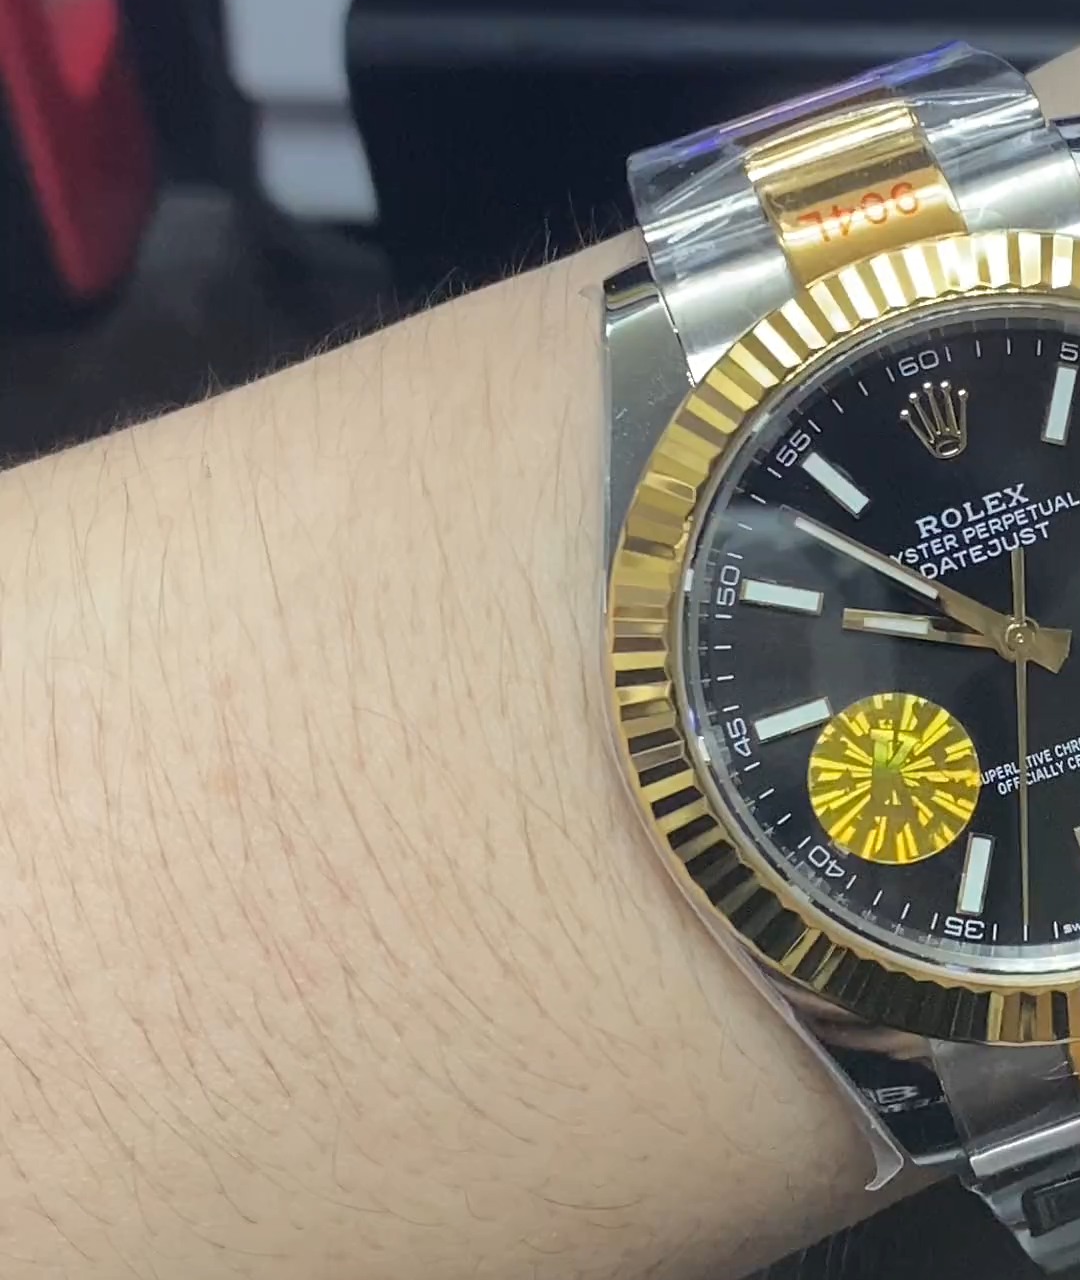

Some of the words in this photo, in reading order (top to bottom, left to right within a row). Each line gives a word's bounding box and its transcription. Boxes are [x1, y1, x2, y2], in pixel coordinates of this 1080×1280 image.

[898, 349, 940, 377] 60
[1060, 341, 1080, 362] 5
[775, 429, 812, 467] 55
[889, 533, 960, 567] YSTER
[962, 491, 1080, 545] PERPETUAL
[915, 482, 1030, 540] ROLEX
[919, 520, 1050, 581] DATEJUST
[716, 564, 741, 607] 50
[726, 717, 752, 757] 45
[979, 749, 1053, 786] UPERLTIVE
[997, 760, 1065, 796] OFFCIALLY
[807, 844, 845, 879] 40
[943, 916, 986, 940] 35
